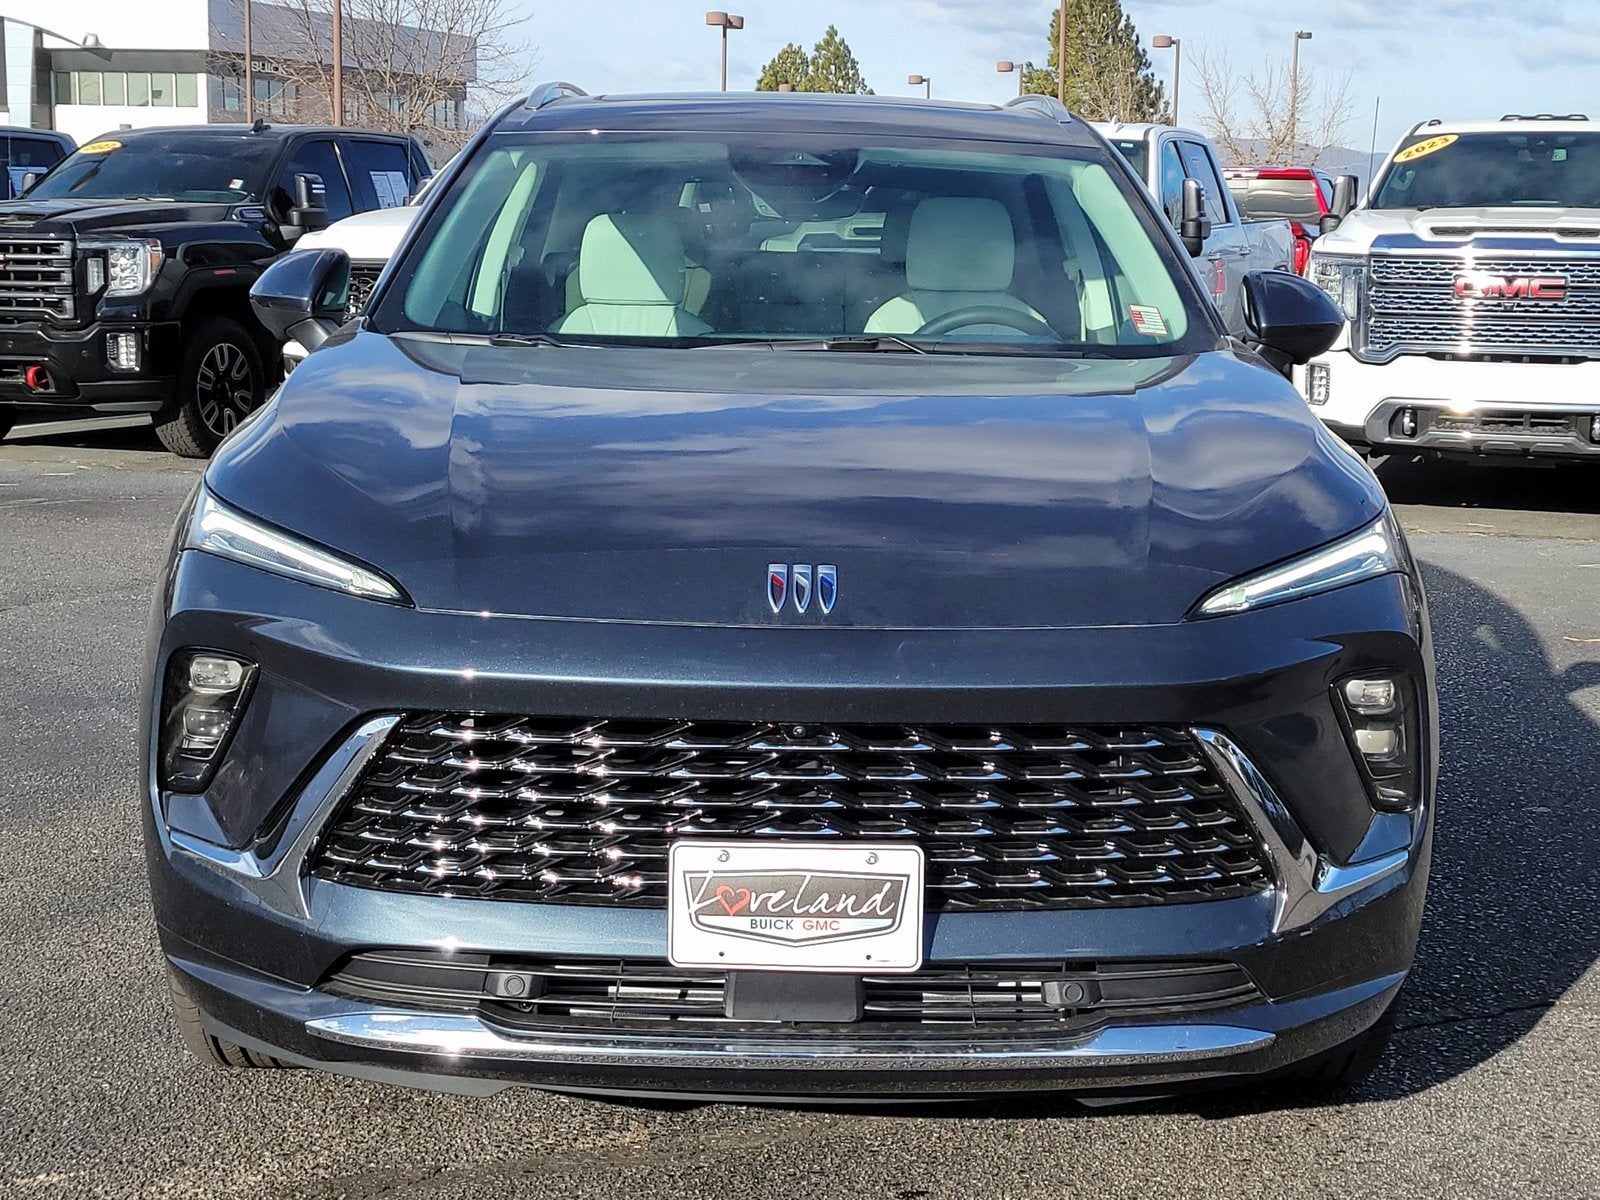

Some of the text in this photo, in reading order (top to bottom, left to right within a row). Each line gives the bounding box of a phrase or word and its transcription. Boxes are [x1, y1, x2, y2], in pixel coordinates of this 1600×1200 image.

[1402, 137, 1450, 159] 2023
[1454, 276, 1567, 300] GMC
[750, 919, 840, 931] BUICK GMC
